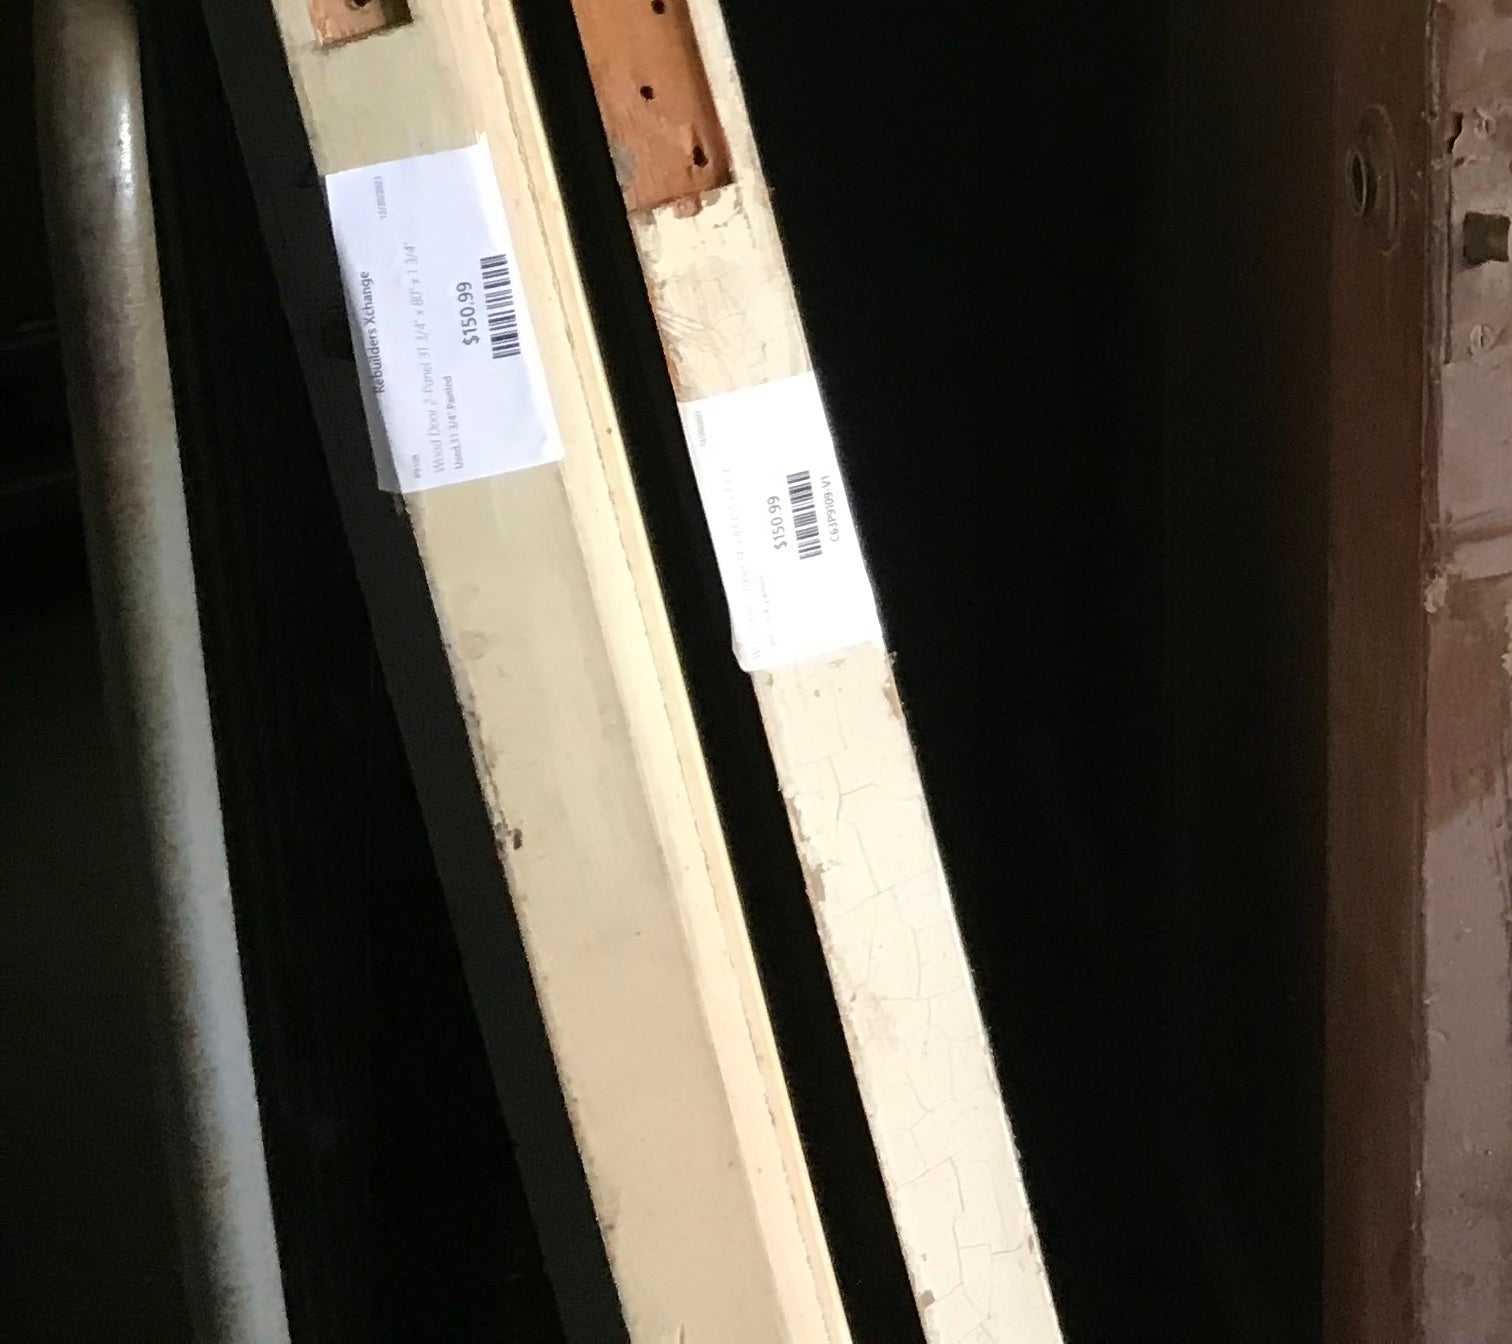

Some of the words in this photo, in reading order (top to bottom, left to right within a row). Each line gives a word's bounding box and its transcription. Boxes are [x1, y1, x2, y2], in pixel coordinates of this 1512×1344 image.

[360, 271, 375, 324] Xchange
[456, 281, 481, 347] $150.99
[366, 325, 385, 395] Rebuilders
[767, 495, 788, 550] $150.99
[820, 475, 840, 543] C63P9109-V1
